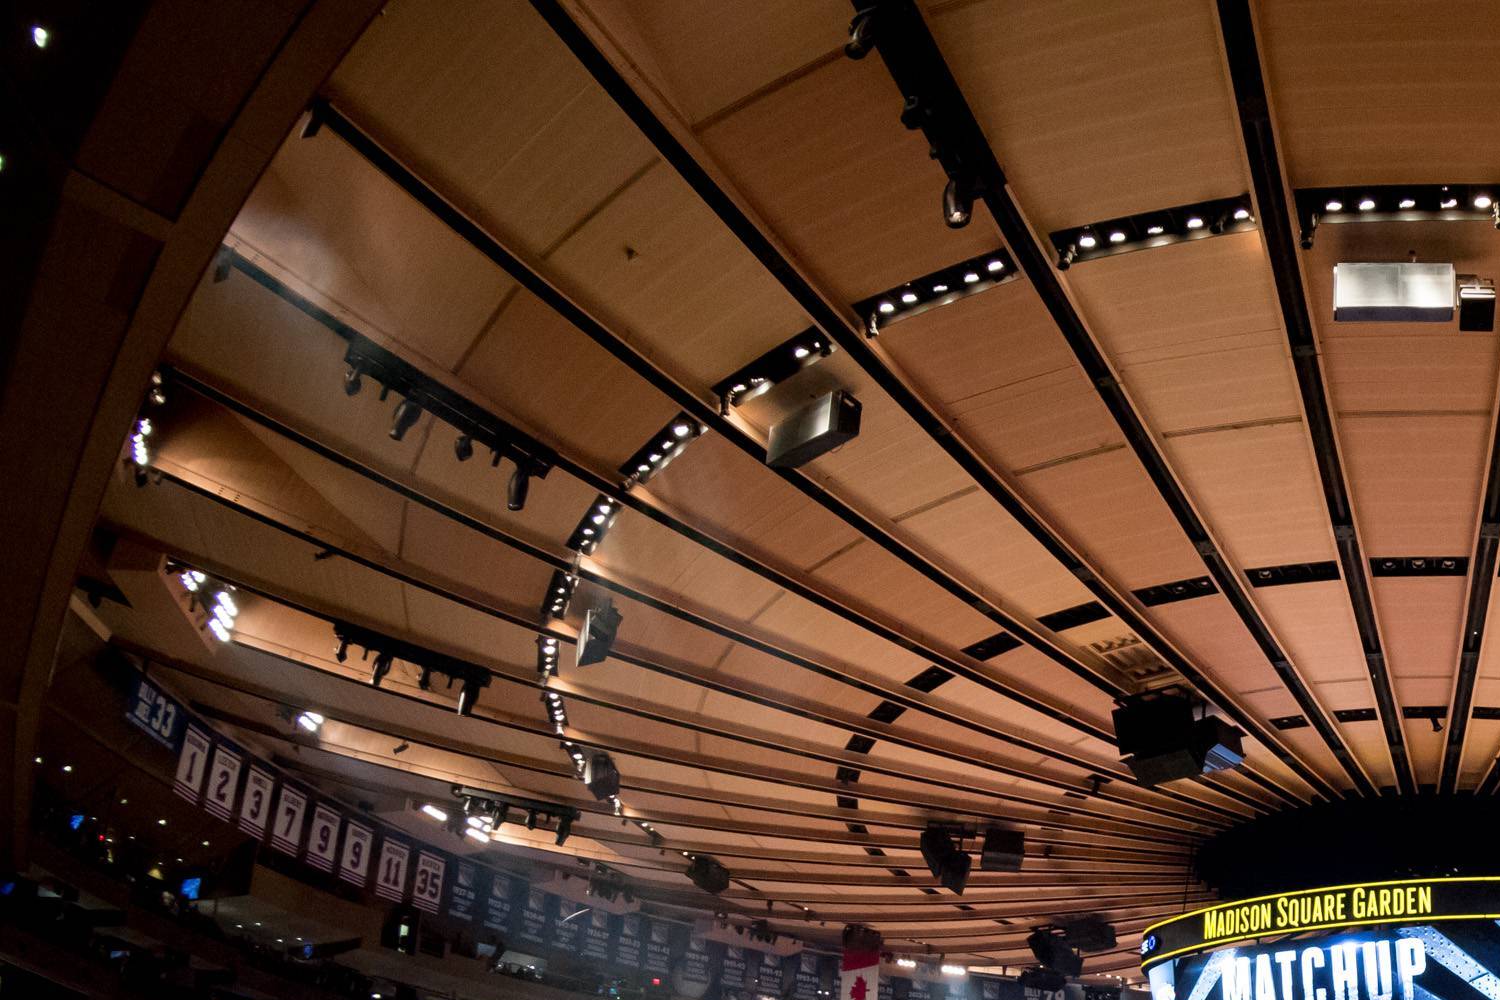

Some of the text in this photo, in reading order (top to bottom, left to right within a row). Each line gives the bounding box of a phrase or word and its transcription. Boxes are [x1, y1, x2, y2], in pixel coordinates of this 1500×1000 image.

[186, 752, 196, 783] 1
[216, 770, 230, 802] 2
[250, 789, 263, 819] 3
[284, 807, 296, 837] 7
[317, 825, 330, 854] 9
[350, 841, 363, 870] 9
[382, 857, 401, 887] 11
[416, 868, 441, 899] 35
[1204, 887, 1432, 939] MADISON SQUARE GARDEN
